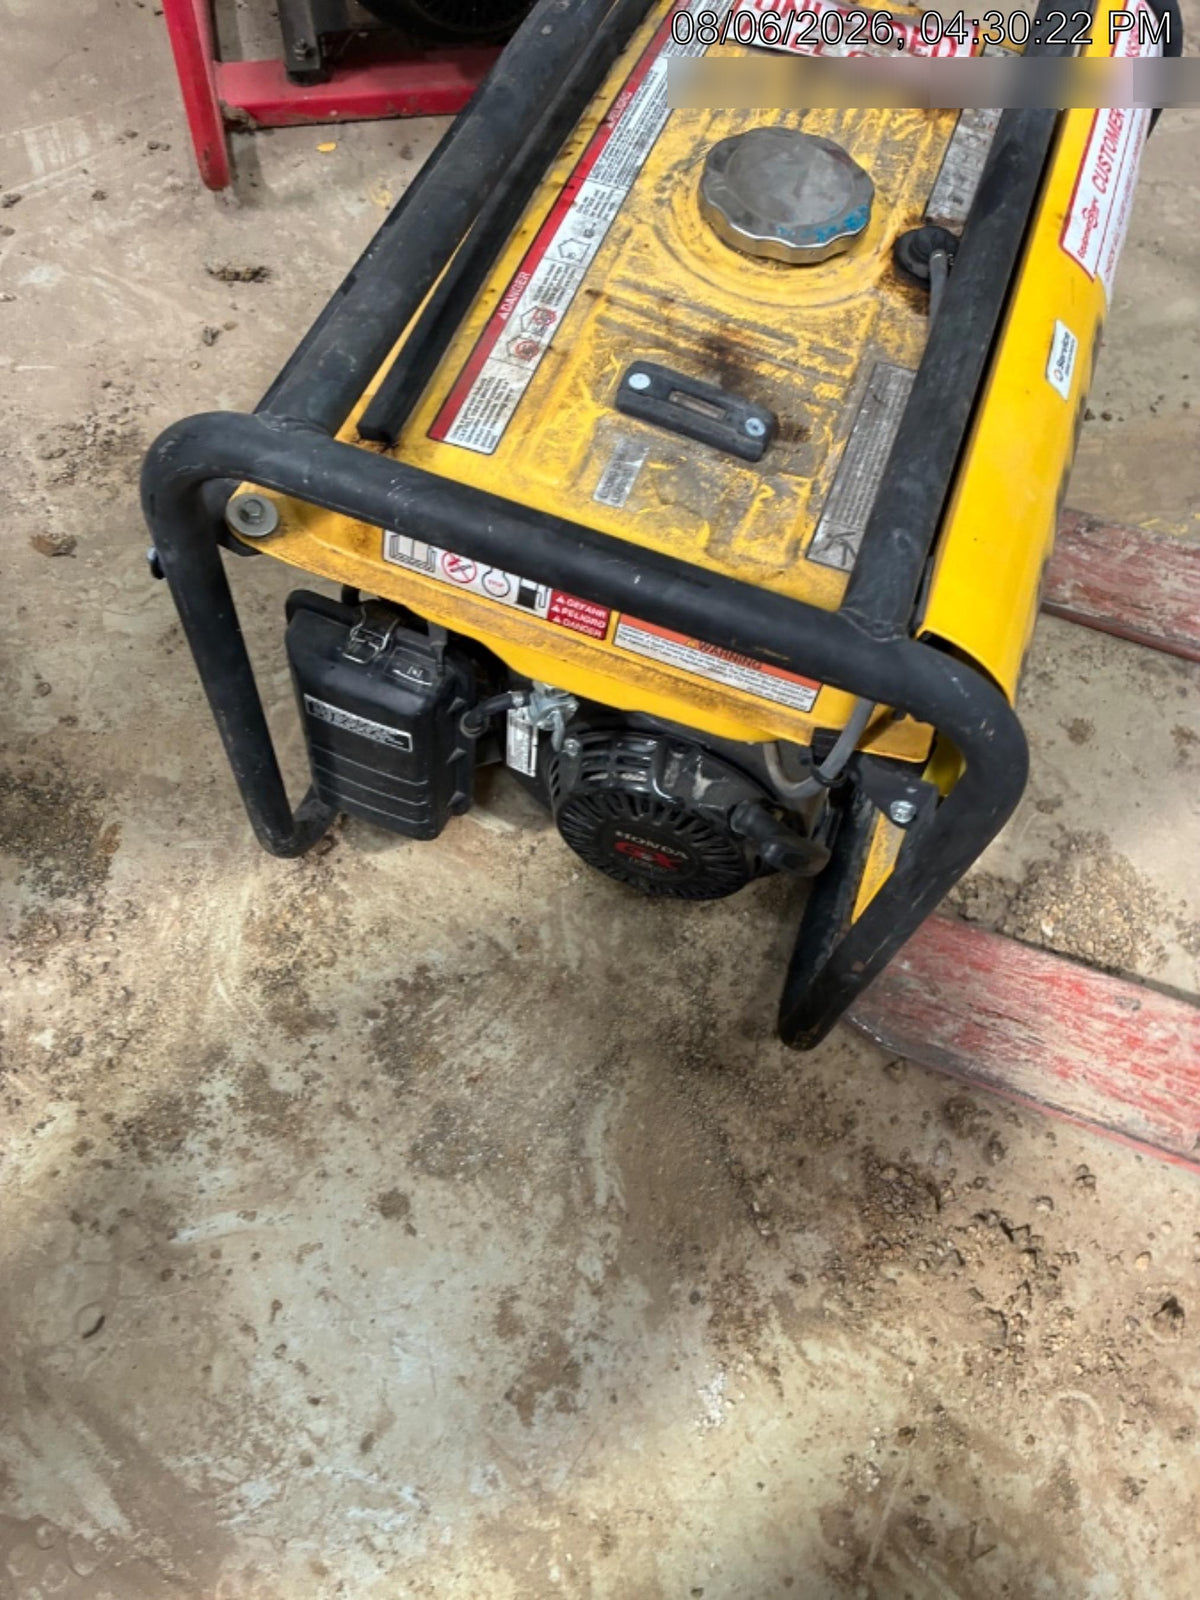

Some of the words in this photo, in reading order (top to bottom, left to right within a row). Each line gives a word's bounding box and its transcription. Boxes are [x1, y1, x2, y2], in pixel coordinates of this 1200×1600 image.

[500, 271, 532, 311] DANGER
[561, 606, 606, 629] PELIGRO
[700, 641, 762, 670] WARNING
[614, 829, 690, 860] HONDA
